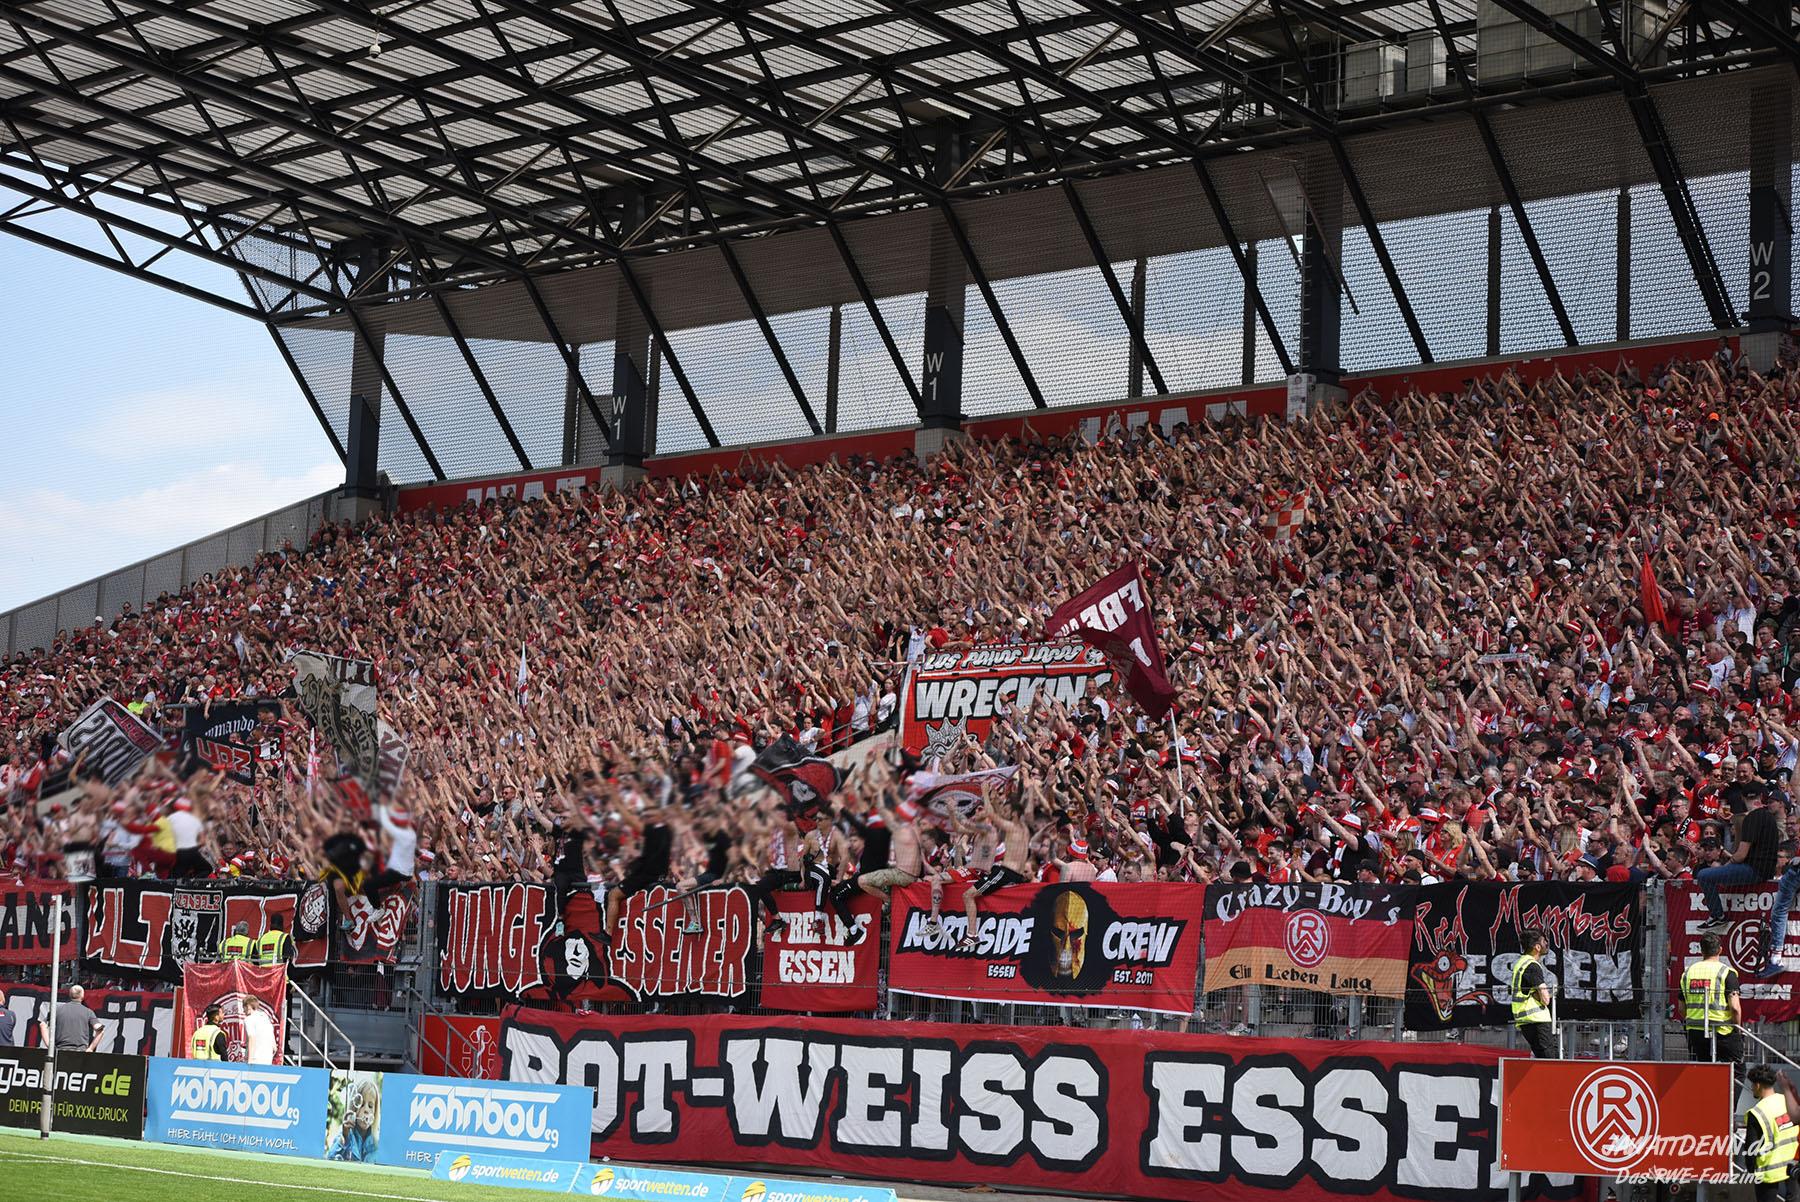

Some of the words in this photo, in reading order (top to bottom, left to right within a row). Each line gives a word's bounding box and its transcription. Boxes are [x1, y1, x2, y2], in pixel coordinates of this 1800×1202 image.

[1751, 241, 1774, 266] W
[1753, 271, 1771, 300] 2
[926, 352, 944, 373] W
[929, 377, 937, 401] 1
[612, 395, 627, 415] W
[614, 418, 621, 440] 1
[1415, 884, 1469, 956] Red
[440, 884, 547, 993] JUNGE
[1102, 921, 1179, 963] CREW
[779, 949, 855, 984] ESSEN
[987, 964, 1016, 978] ESSEN
[1265, 964, 1319, 985] Leben
[1135, 971, 1153, 985] 2011
[9, 1098, 29, 1113] DEIN
[57, 1101, 74, 1118] FÜR
[75, 1104, 129, 1123] XXXL-DRUCK
[168, 1128, 191, 1140] HIER
[221, 1132, 236, 1144] ICH
[239, 1135, 263, 1147] MICH
[406, 1150, 432, 1163] HIER
[471, 1164, 560, 1183] sportwetten.de
[615, 1178, 709, 1197] sportwetten.de
